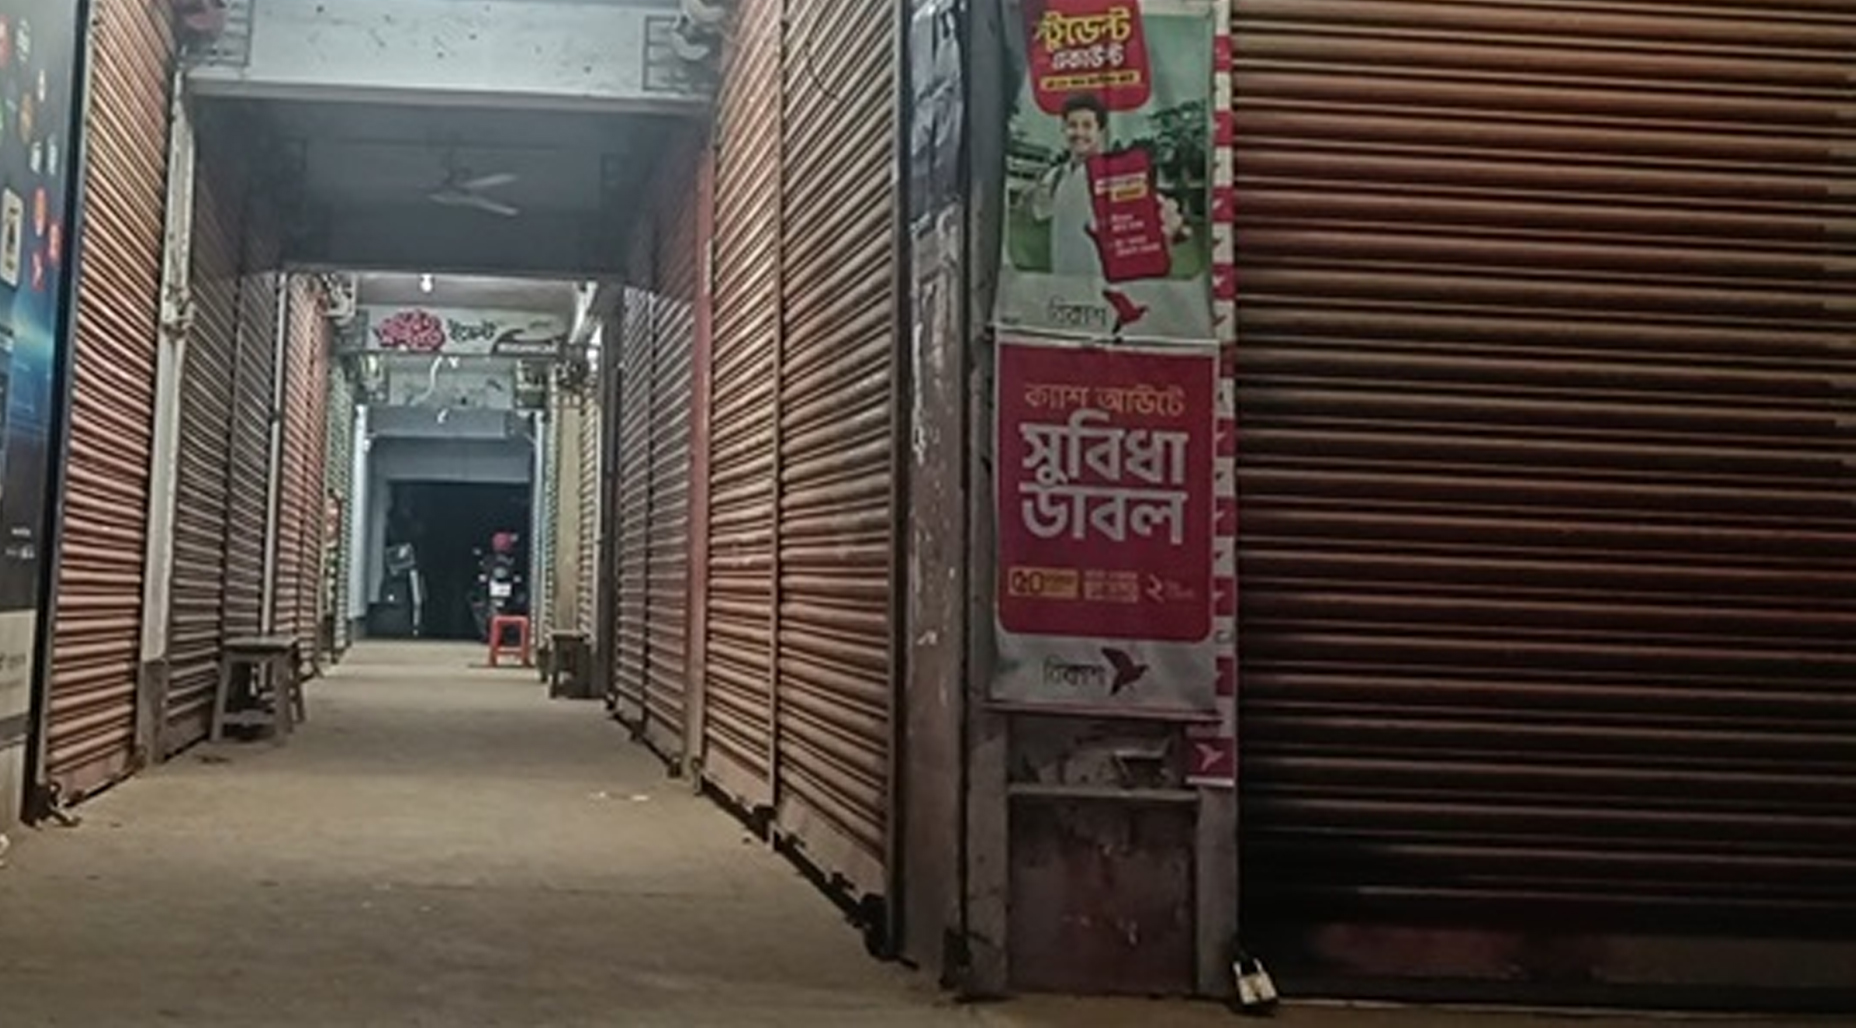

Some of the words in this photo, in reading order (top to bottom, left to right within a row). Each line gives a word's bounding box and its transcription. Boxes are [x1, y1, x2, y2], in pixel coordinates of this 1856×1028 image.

[1024, 382, 1089, 409] ক্যাশ
[1095, 382, 1186, 417] আউটে
[1018, 408, 1190, 484] সুবিধা
[1018, 482, 1189, 545] ডাবল
